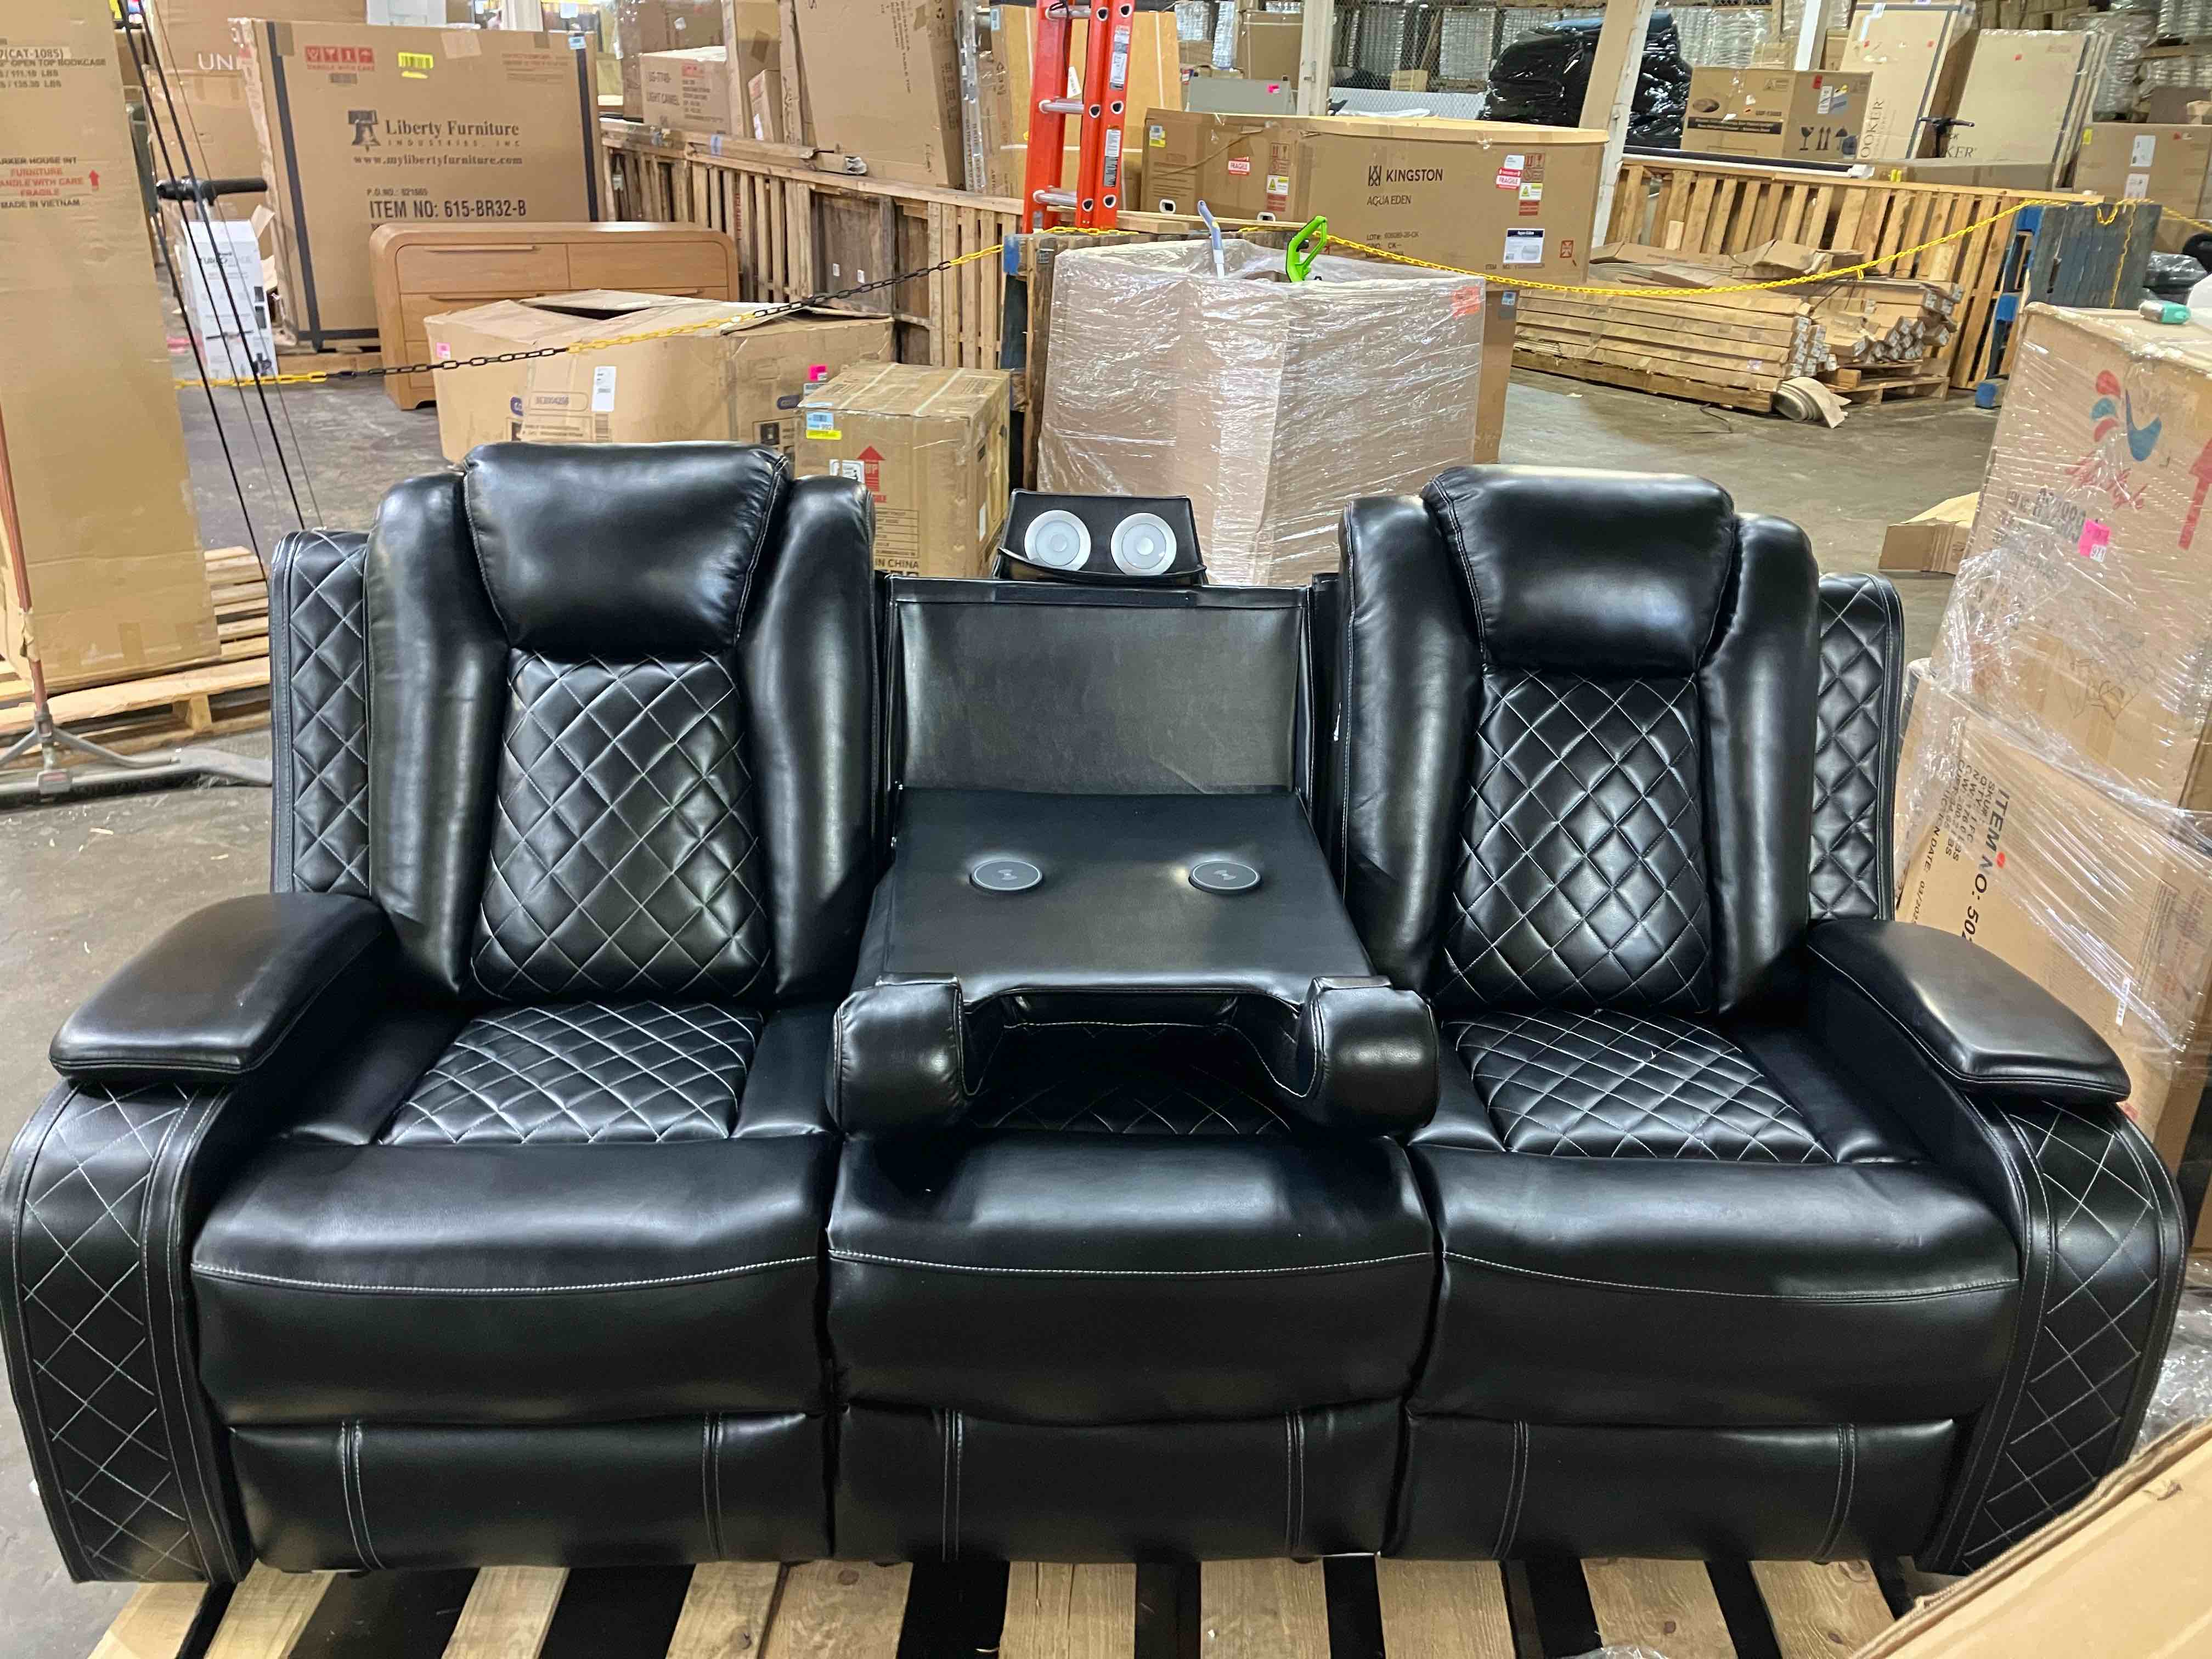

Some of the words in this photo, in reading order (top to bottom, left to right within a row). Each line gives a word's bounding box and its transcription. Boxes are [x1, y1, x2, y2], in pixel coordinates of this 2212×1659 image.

[386, 119, 442, 139] Liberty
[447, 120, 520, 136] Furniture
[353, 154, 523, 167] www.mylibertyfurniture.com
[12, 167, 63, 176] FURNITURE
[1386, 168, 1443, 183] KINGSTON
[20, 188, 59, 197] FRAGILE
[1, 200, 27, 208] MADE
[41, 199, 80, 207] VIETNAM
[1367, 195, 1389, 206] AQUA
[1391, 194, 1412, 205] EDEN
[369, 200, 407, 218] ITEM
[413, 200, 439, 218] NO:
[444, 199, 527, 218] 615-BR32-B
[875, 558, 885, 567] IN
[888, 558, 919, 568] CHINA
[1985, 787, 2010, 852] ITEM
[1972, 854, 1993, 900] NO:
